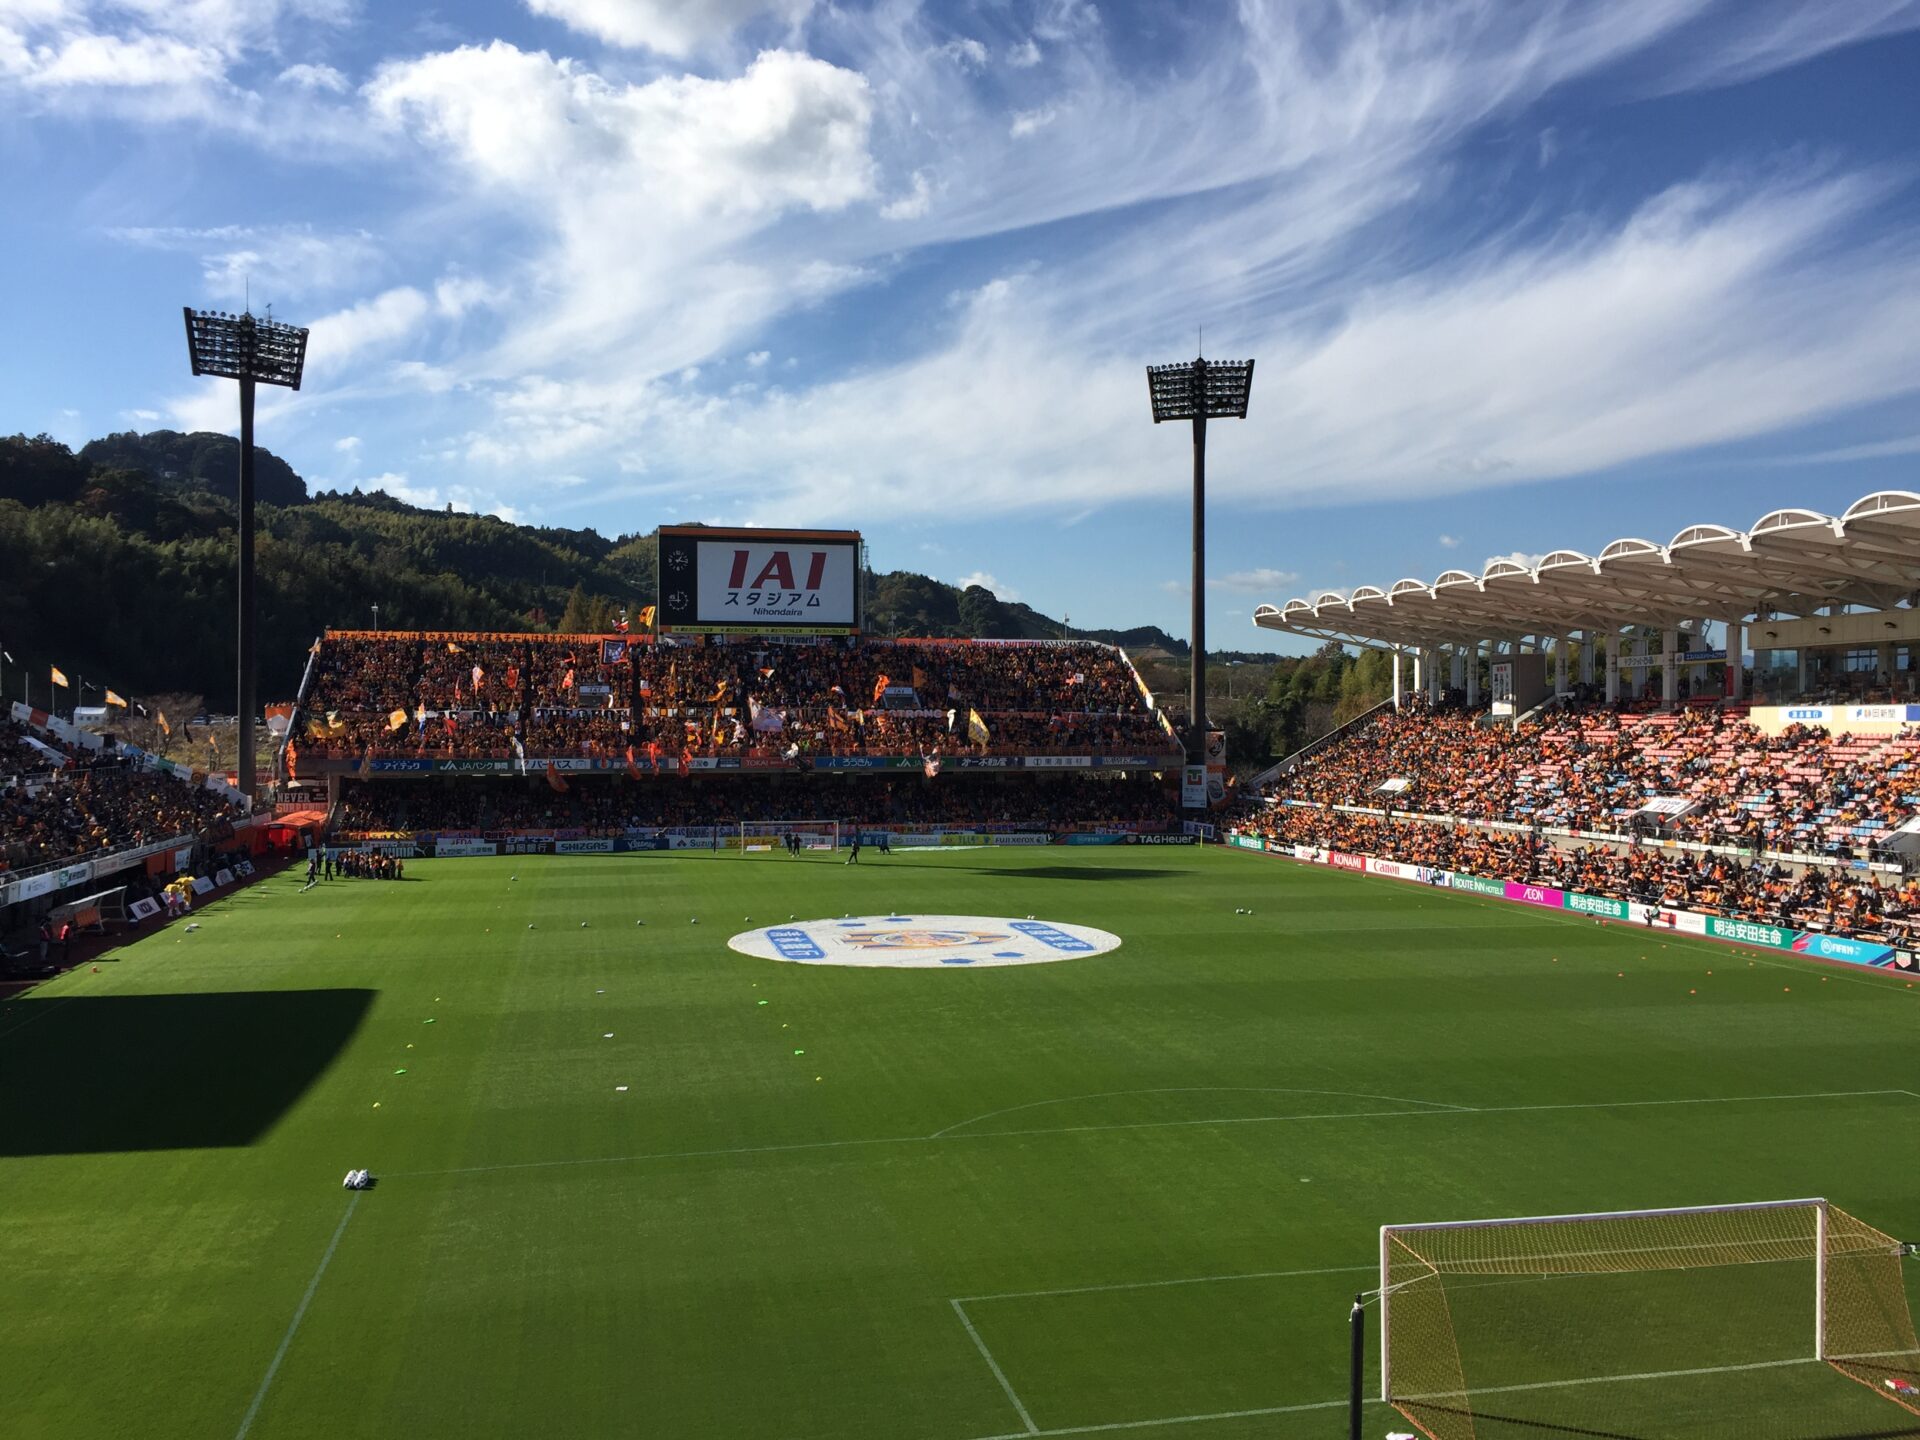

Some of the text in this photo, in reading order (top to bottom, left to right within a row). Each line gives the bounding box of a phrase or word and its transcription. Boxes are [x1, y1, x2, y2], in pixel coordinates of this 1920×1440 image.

[728, 550, 827, 590] IAI
[725, 592, 820, 607] スタジアム
[753, 607, 803, 617] Nihondaira
[842, 758, 873, 767] ろうきん
[277, 793, 311, 803] NEVER
[1139, 836, 1194, 844] TAG Heuer
[506, 844, 548, 854] 静岡銀行
[561, 843, 608, 851] SHIZGAS
[1333, 855, 1362, 868] KONAMI
[1373, 862, 1400, 875] Canon
[1455, 877, 1474, 891] ROUTE
[1570, 895, 1622, 916] 明治安田生命
[1714, 919, 1782, 946] 明治安田生命
